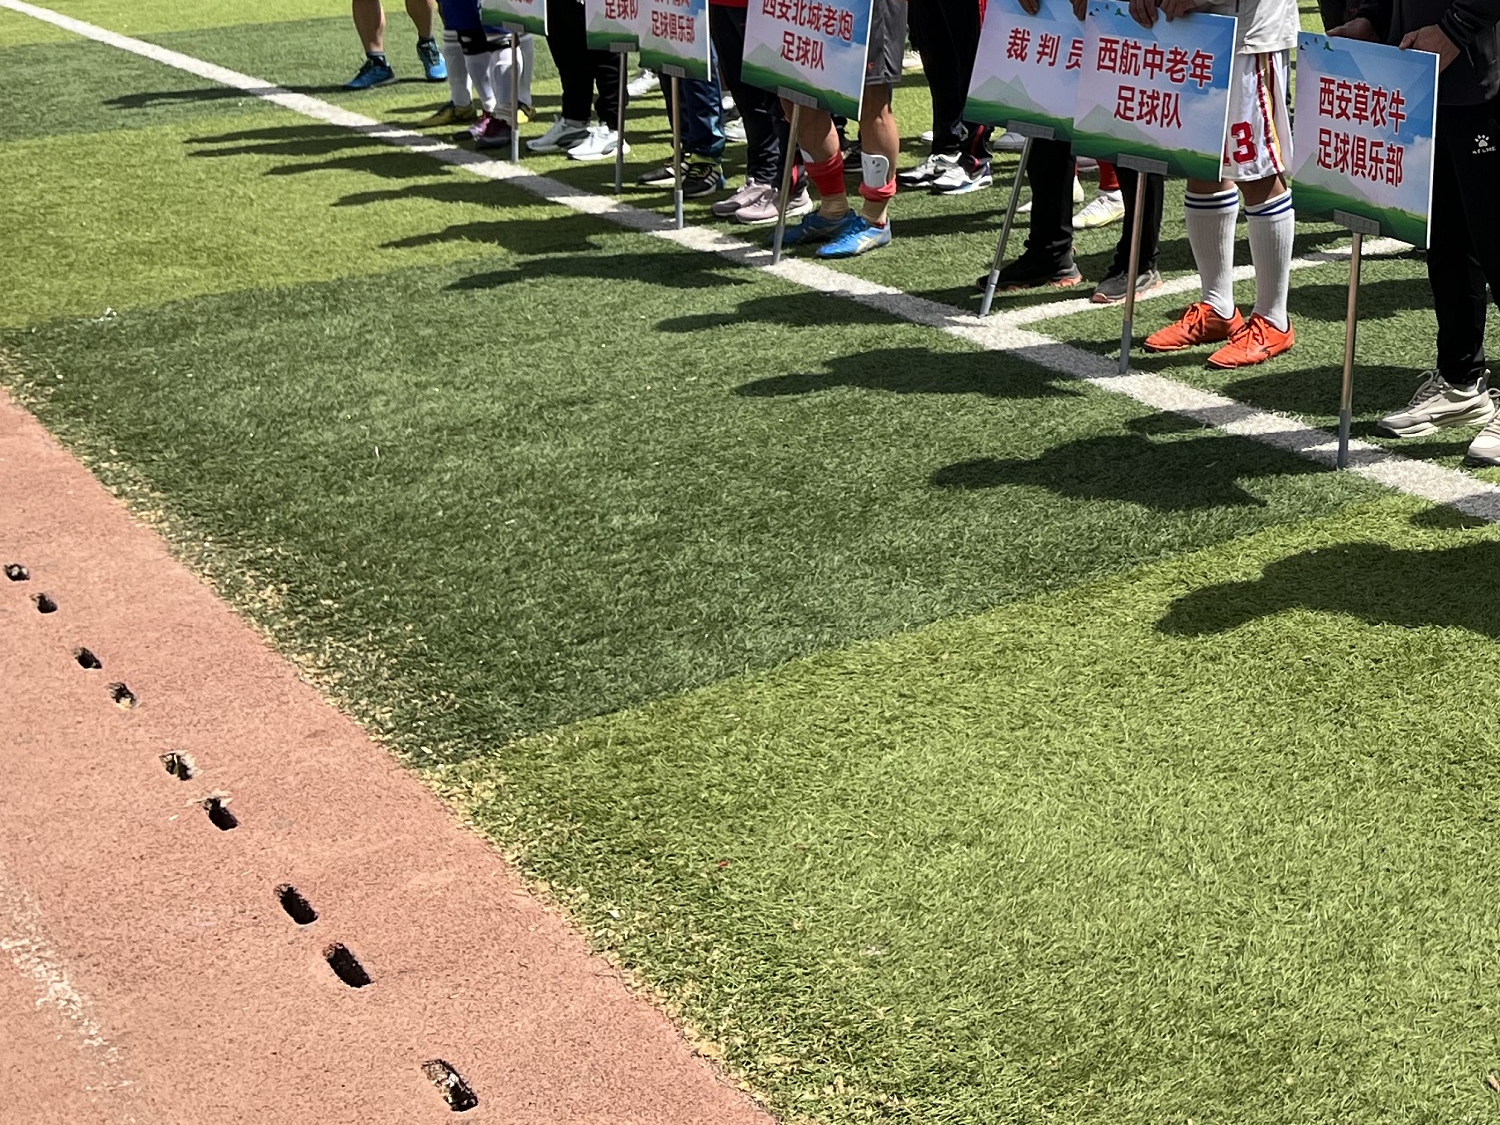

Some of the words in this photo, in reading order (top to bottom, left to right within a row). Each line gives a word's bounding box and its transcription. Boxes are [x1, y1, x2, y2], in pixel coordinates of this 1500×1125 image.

[651, 10, 696, 43] 足球俱乐部
[1006, 27, 1084, 71] 裁判员
[780, 30, 825, 71] 足球队
[1096, 36, 1215, 88] 西航中老年
[1114, 84, 1183, 130] 足球队
[1319, 77, 1407, 134] 西安草农牛
[1316, 127, 1405, 188] 足球俱乐部
